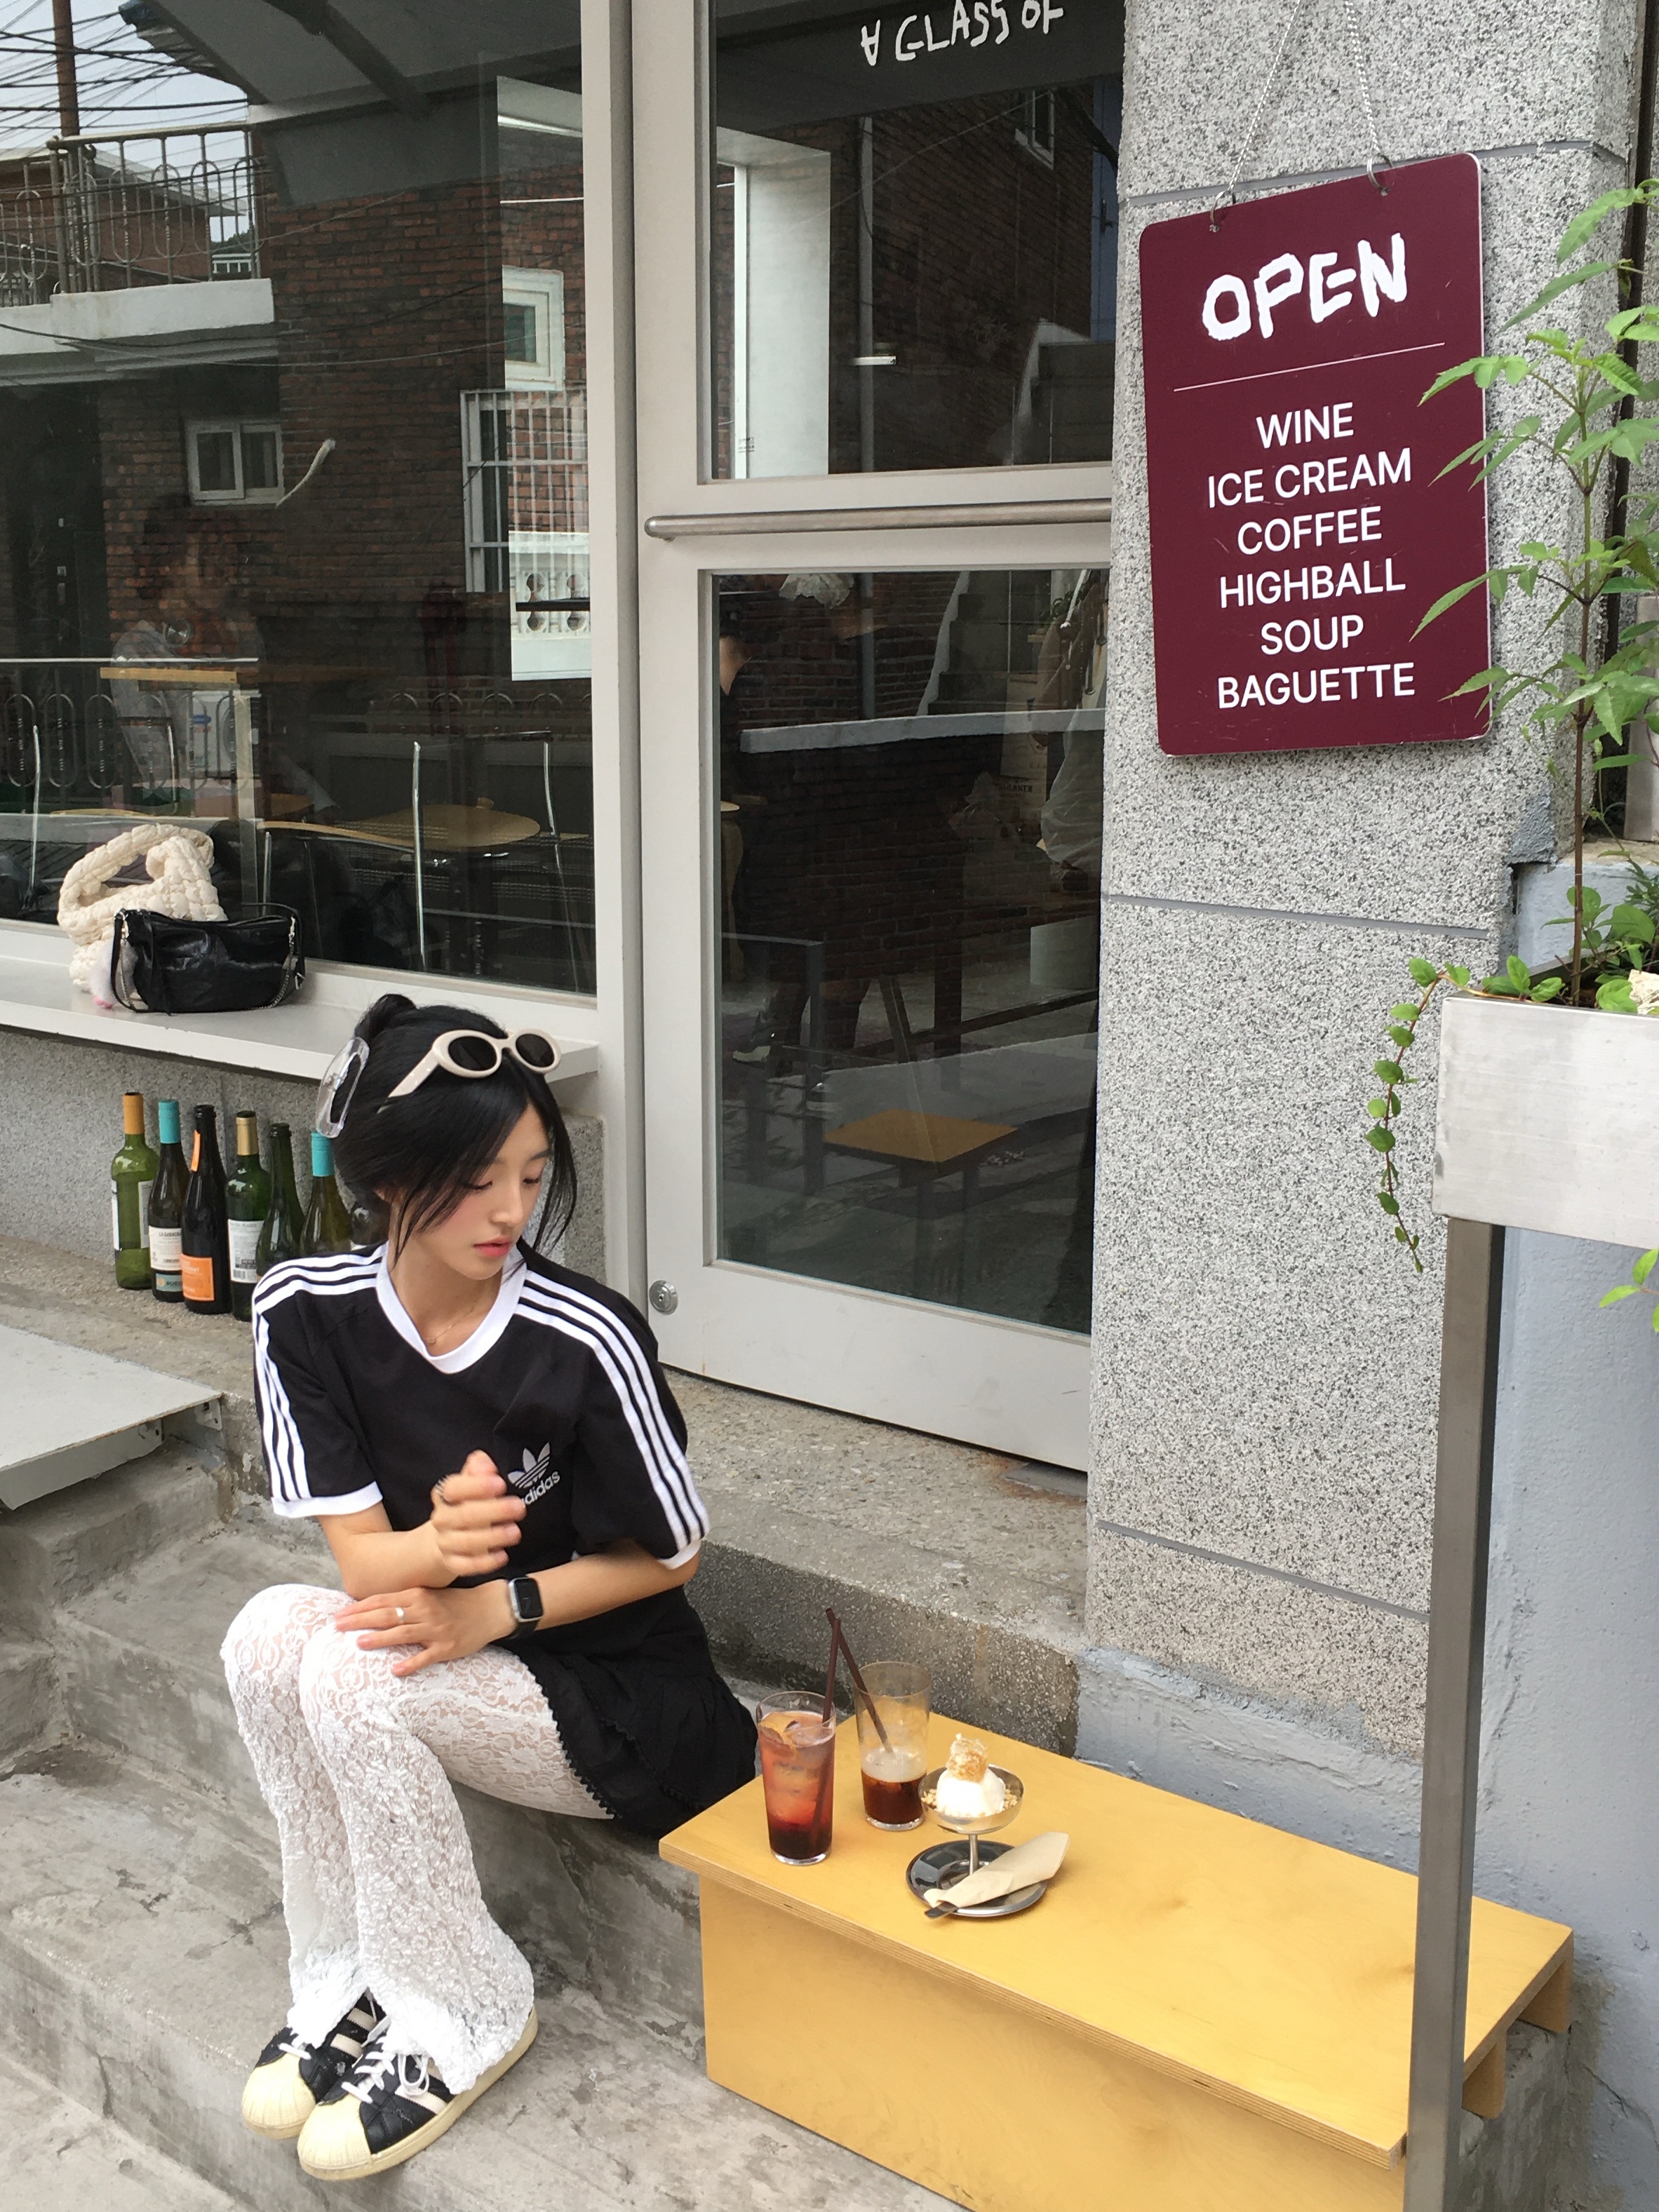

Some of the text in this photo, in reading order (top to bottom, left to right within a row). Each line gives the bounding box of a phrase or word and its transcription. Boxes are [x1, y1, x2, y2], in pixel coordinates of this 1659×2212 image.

[896, 0, 1009, 61] GLASS
[1202, 233, 1407, 342] OPEN
[1256, 403, 1353, 448] WINE
[1209, 447, 1411, 508] ICE CREAM
[1237, 506, 1381, 554] COFFEE
[1220, 558, 1406, 608] HIGHBALL
[1261, 615, 1363, 654] SOUP
[1218, 663, 1415, 709] BAGUETTE
[522, 1471, 560, 1504] didas
